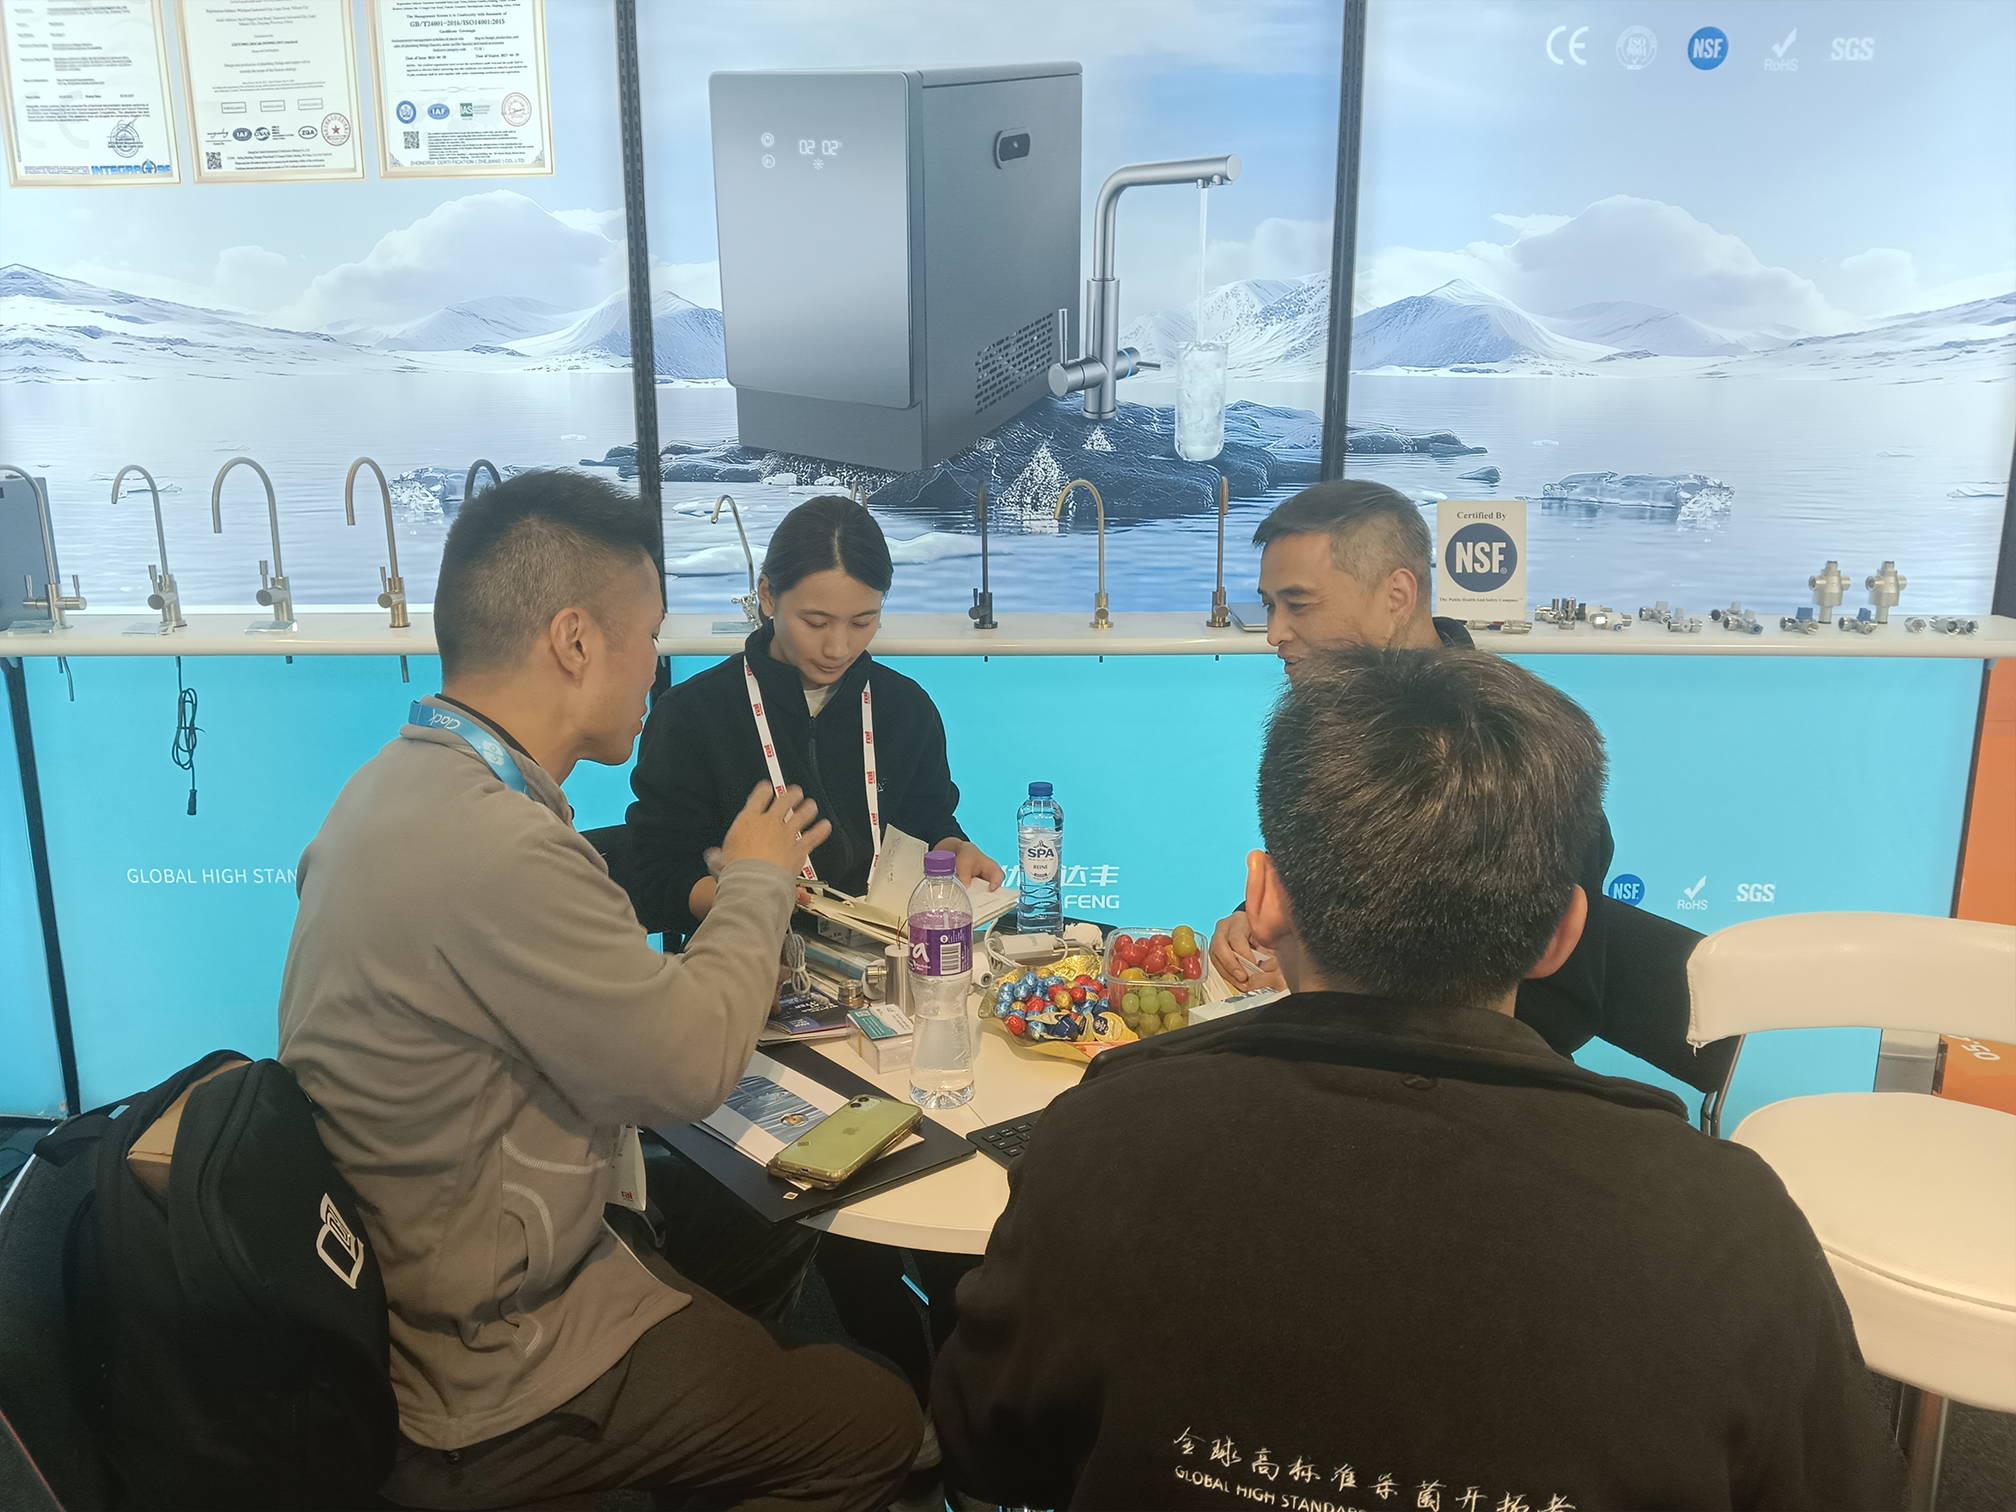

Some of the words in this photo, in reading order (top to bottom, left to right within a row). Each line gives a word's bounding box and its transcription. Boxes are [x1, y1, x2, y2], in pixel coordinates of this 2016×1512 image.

[1546, 25, 1589, 66] CE
[1693, 38, 1723, 59] NSF
[1831, 37, 1875, 61] SGS
[1764, 58, 1798, 71] RoHS
[1456, 511, 1494, 520] Certified
[1495, 512, 1507, 521] By
[1455, 541, 1507, 574] NSF
[429, 709, 461, 731] Clack
[1028, 848, 1055, 858] SPA
[127, 868, 197, 884] GLOBAL
[202, 868, 248, 884] HIGH
[1613, 882, 1640, 900] NSF
[1736, 883, 1775, 902] SGS
[1677, 899, 1708, 910] RoHS
[1175, 1465, 1230, 1493] GLOBAL
[1236, 1484, 1275, 1506] HIGH
